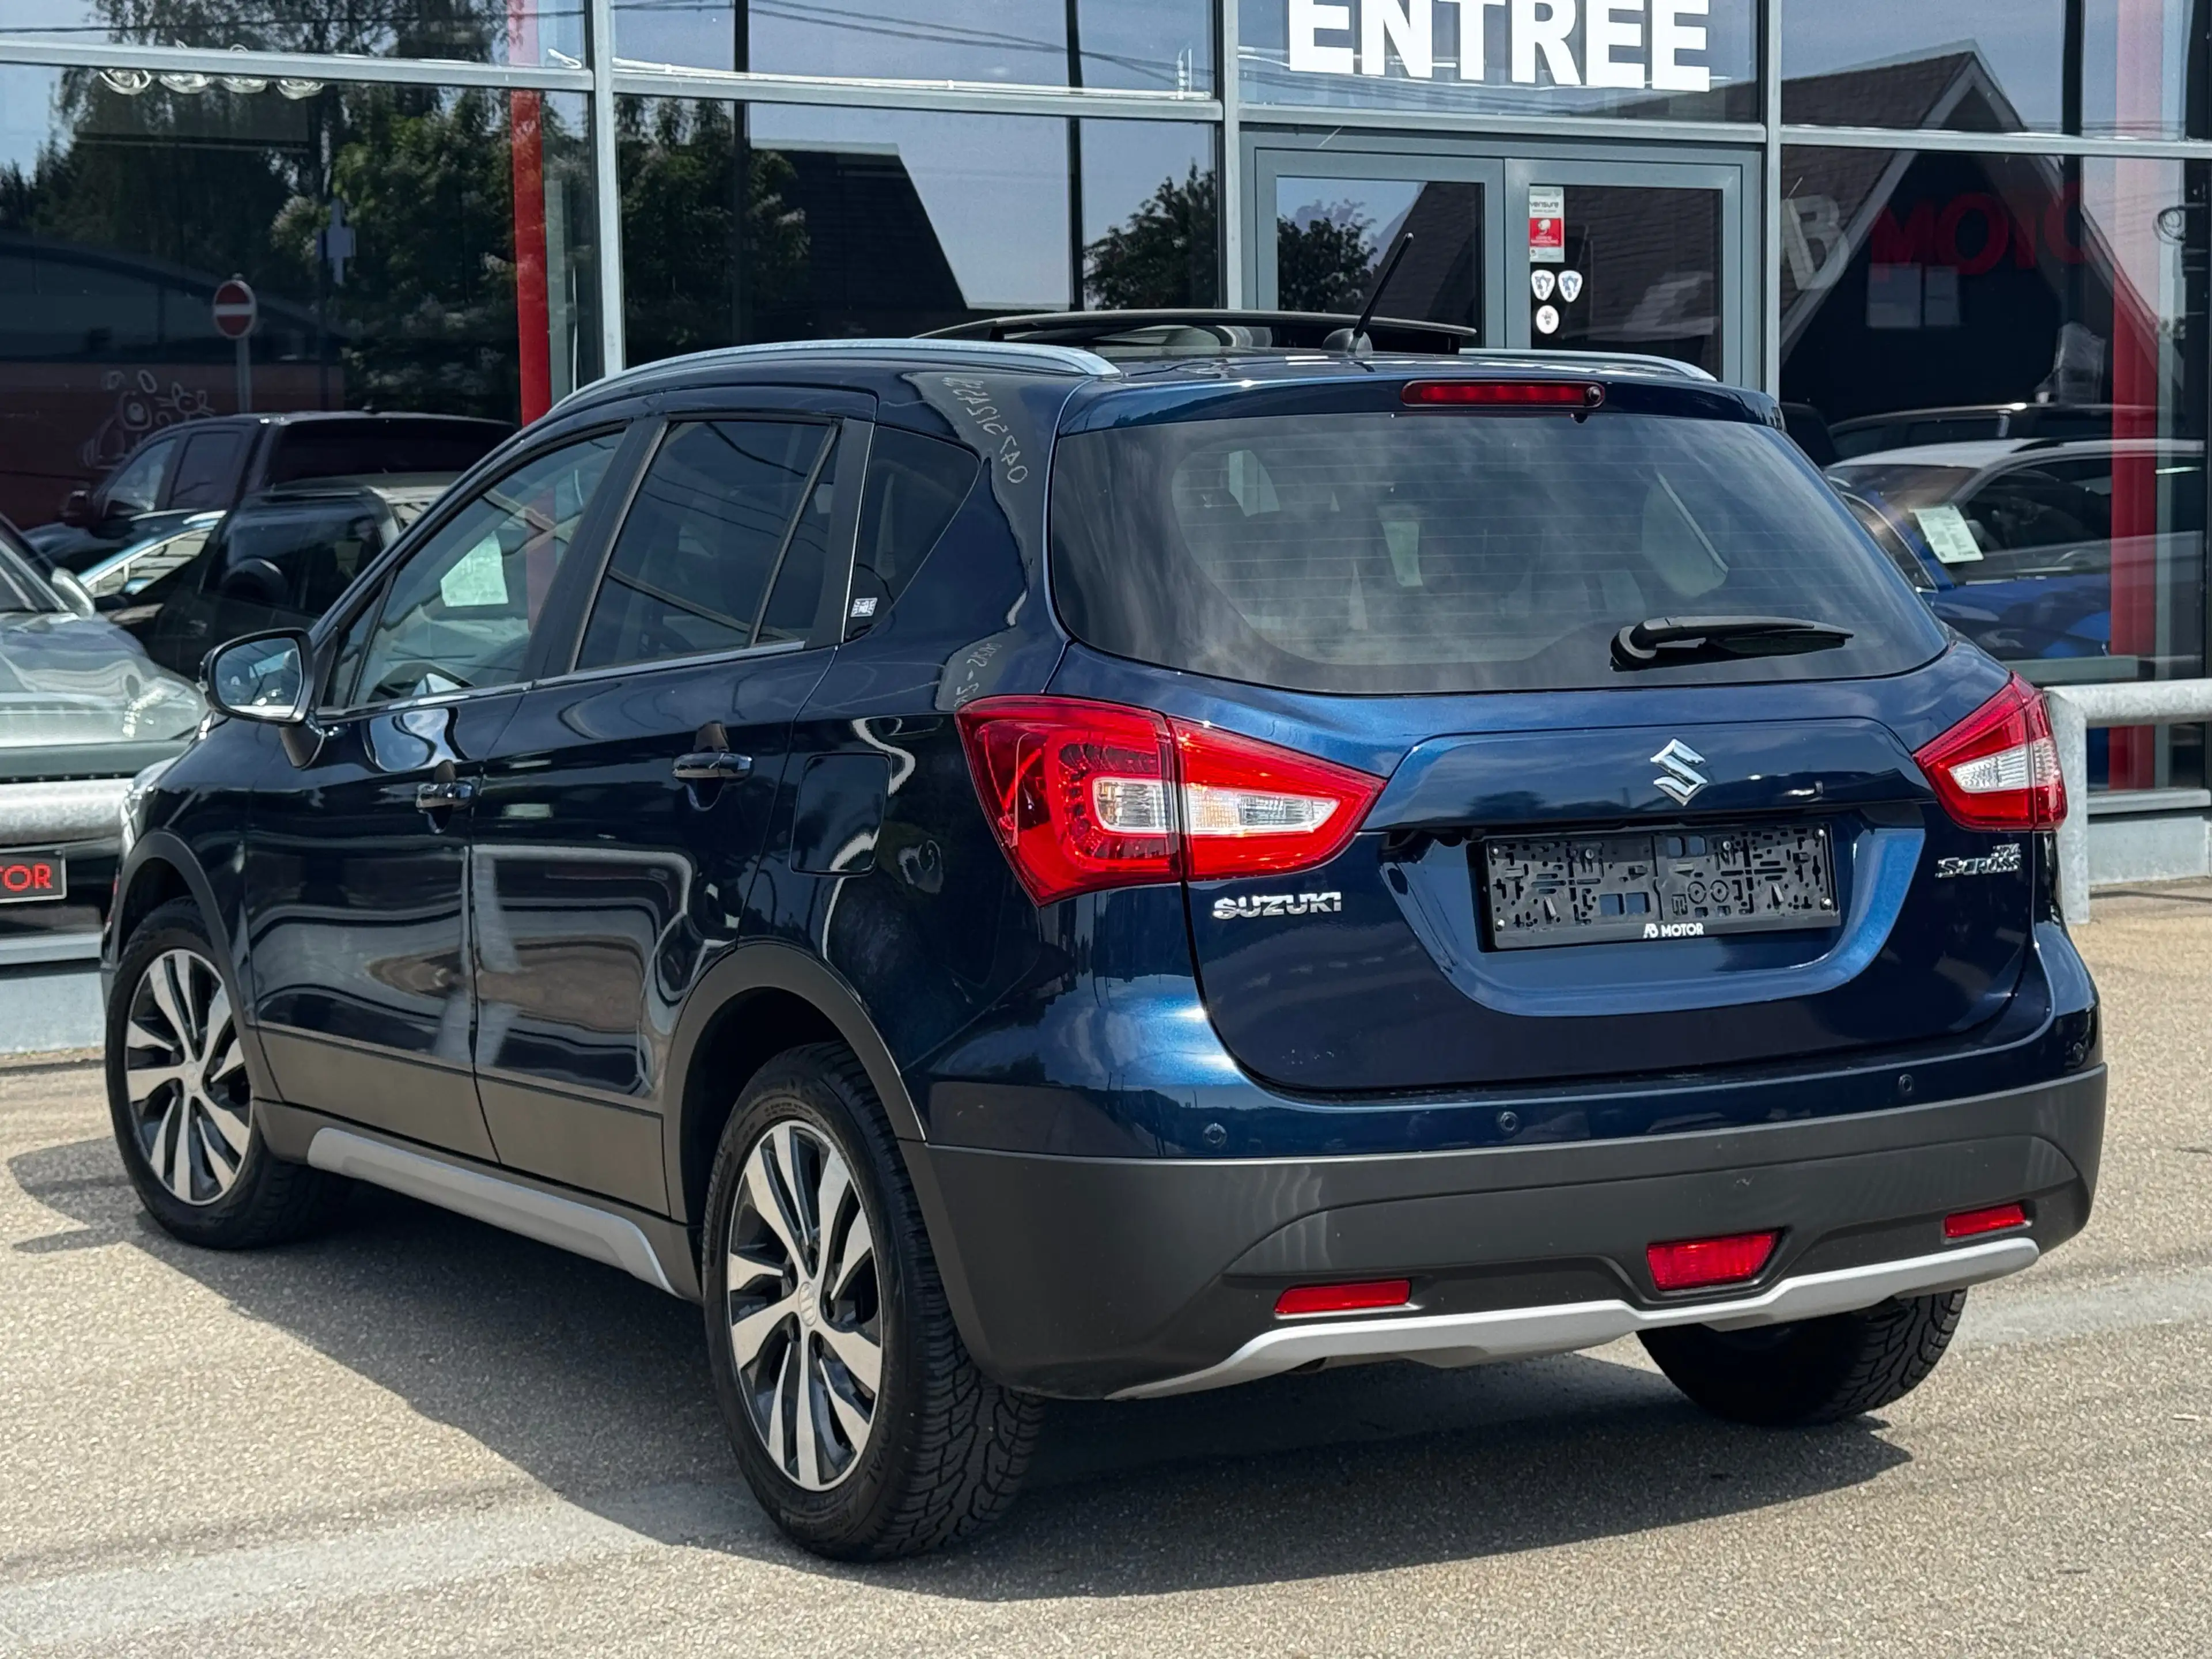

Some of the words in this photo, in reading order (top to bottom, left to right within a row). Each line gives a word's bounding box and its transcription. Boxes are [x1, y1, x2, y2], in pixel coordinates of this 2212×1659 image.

[1289, 0, 1710, 92] ENTREE
[0, 863, 53, 892] OR
[1213, 892, 1342, 920] SUZUKI
[1661, 922, 1705, 937] MOTOR
